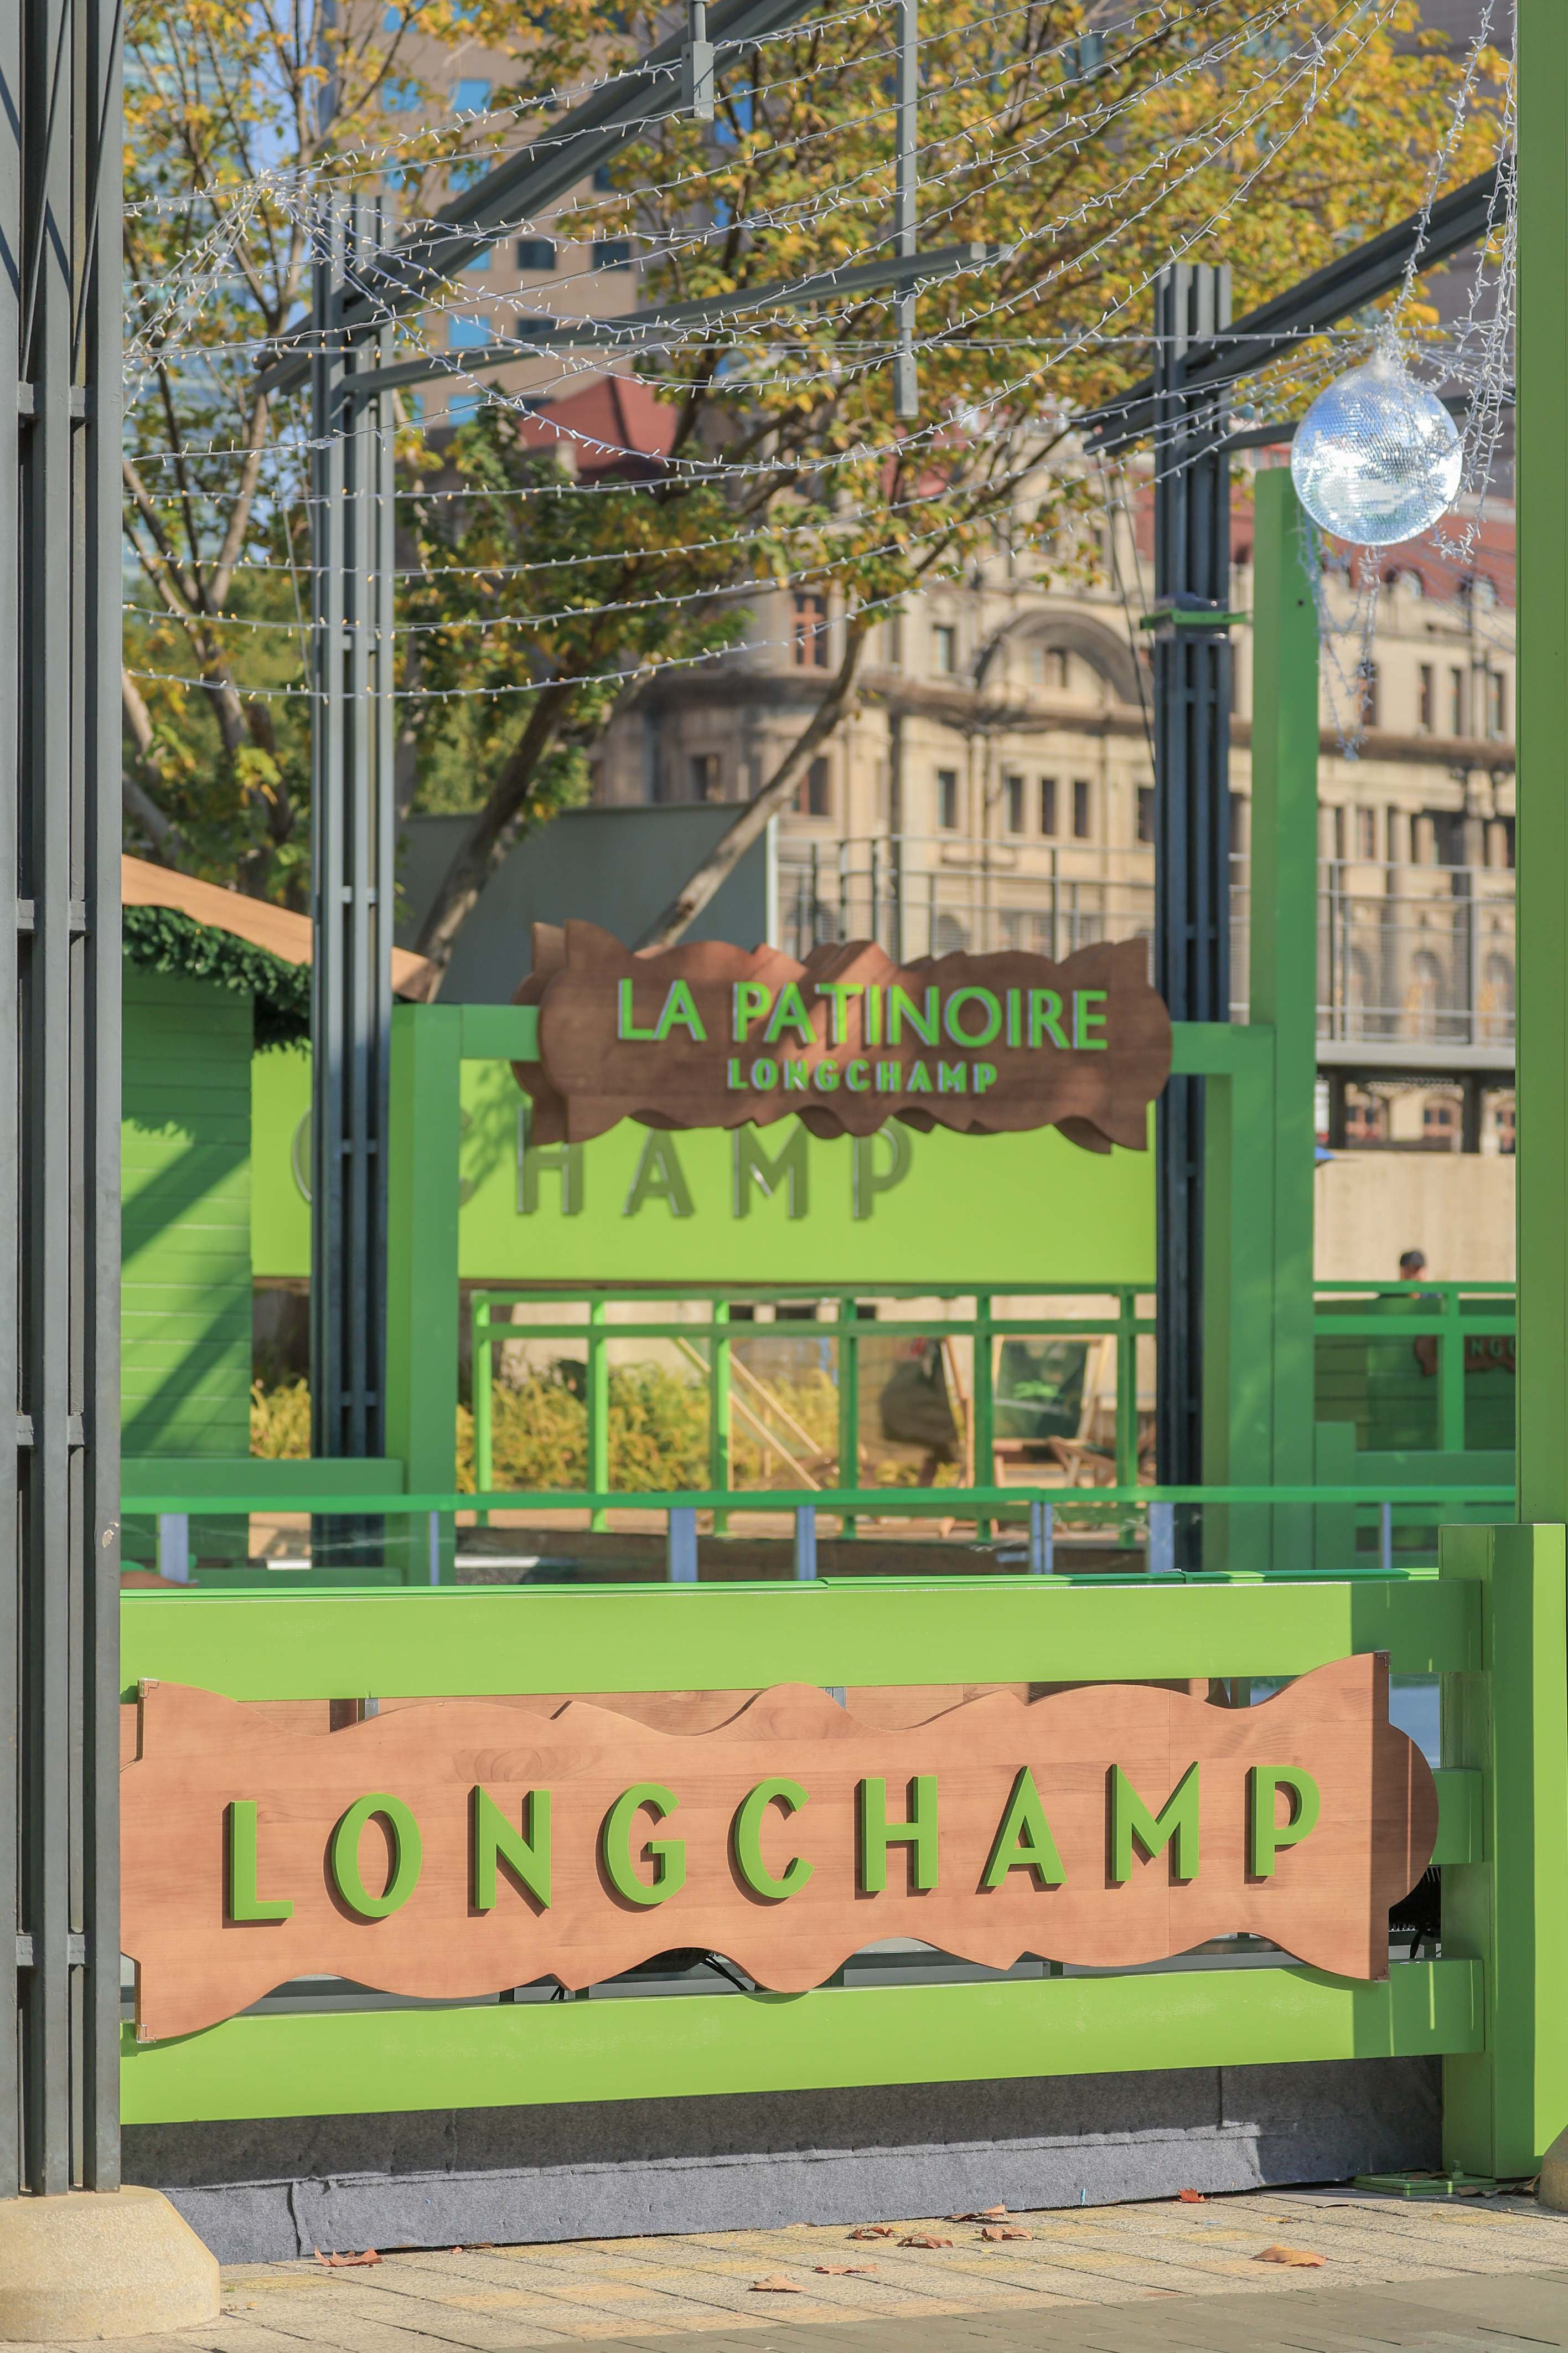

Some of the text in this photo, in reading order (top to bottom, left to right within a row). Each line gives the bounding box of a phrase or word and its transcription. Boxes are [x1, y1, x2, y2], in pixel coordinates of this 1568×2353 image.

[618, 978, 1108, 1050] LA PATINOIRE
[727, 1057, 997, 1093] LONGCHAMP
[229, 1761, 1321, 1921] LONGCHAMP
